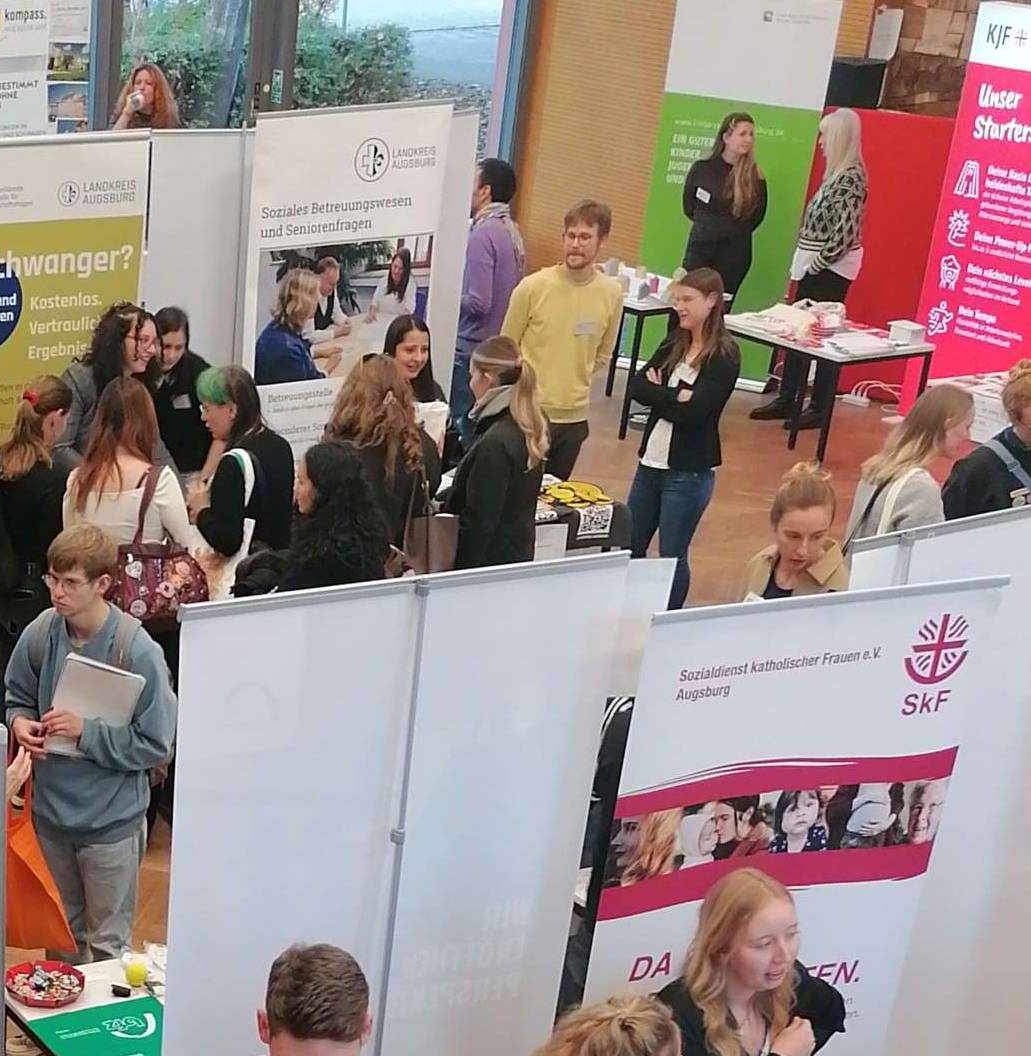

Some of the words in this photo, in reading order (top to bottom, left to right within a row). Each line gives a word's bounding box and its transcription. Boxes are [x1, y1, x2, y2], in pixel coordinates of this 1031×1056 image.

[4, 8, 47, 23] kompass.
[986, 23, 1012, 50] KJF
[978, 83, 1023, 109] Unser
[392, 146, 436, 158] LANDKREIS
[392, 157, 436, 169] AUGSBURG
[83, 180, 136, 193] LANDKREIS
[82, 192, 136, 205] AUGSBURG
[261, 203, 309, 220] Soziales
[311, 195, 412, 215] Betreuungswesen
[260, 226, 283, 239] und
[286, 218, 372, 238] Seniorenfragen
[30, 292, 102, 311] Kostenlos.
[679, 662, 749, 683] Sozialdienst
[750, 654, 821, 676] katholischer
[822, 649, 861, 667] Frauen
[862, 646, 882, 661] e.V.
[676, 684, 731, 702] Augsburg
[901, 688, 952, 716] SkF
[628, 952, 672, 983] DA
